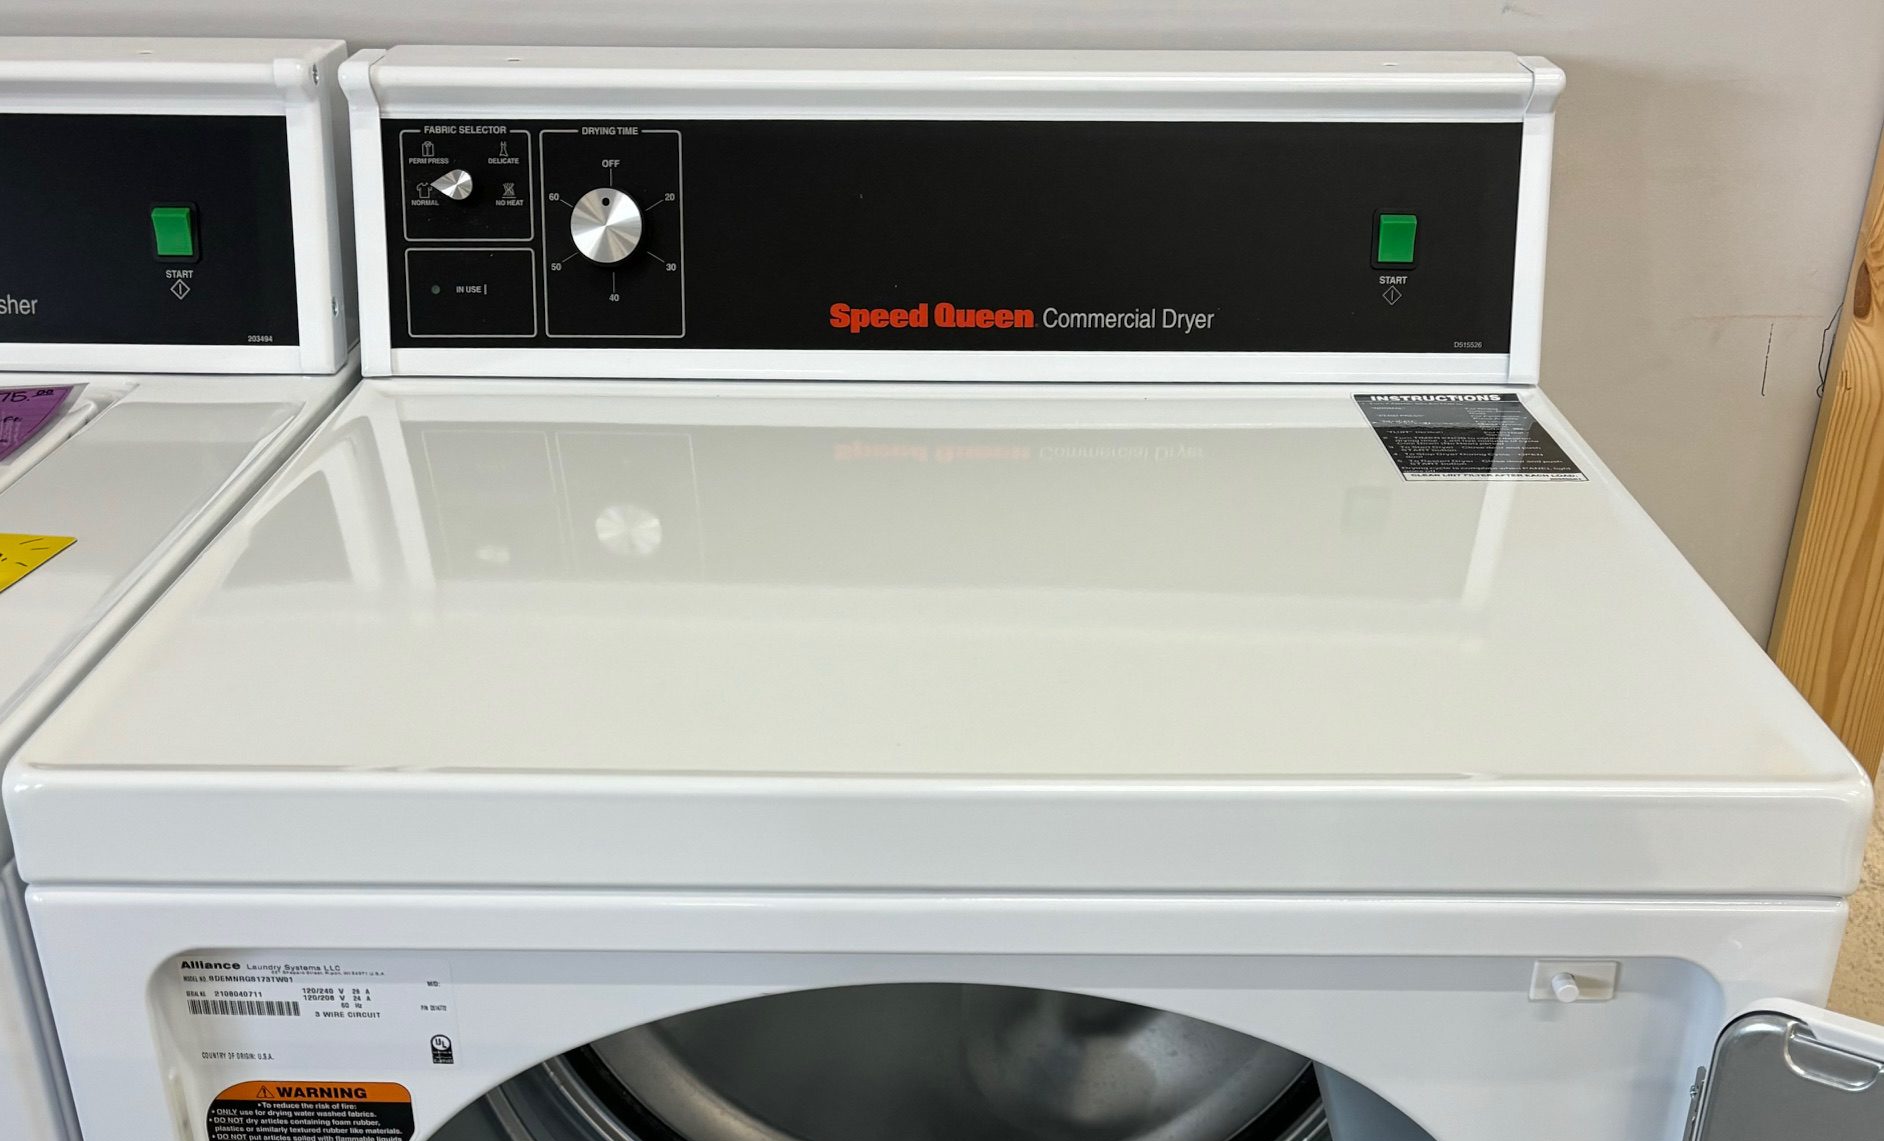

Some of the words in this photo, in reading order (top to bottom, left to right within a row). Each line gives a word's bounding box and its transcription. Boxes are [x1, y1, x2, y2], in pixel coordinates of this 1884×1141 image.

[424, 126, 457, 134] FABRIC
[459, 126, 507, 134] SELECTOR
[582, 127, 616, 135] DRYING
[618, 127, 639, 135] TIME
[602, 160, 620, 168] OFF
[549, 193, 560, 201] 60
[665, 193, 675, 201] 20
[551, 263, 562, 271] 50
[666, 263, 677, 271] 30
[166, 270, 194, 278] START
[1379, 276, 1408, 285] START
[609, 294, 619, 302] 40
[0, 294, 38, 315] sher
[830, 303, 928, 333] Speed
[934, 302, 1034, 329] Queen
[1043, 307, 1156, 329] Commercial
[1162, 308, 1214, 334] Dryer
[181, 961, 240, 970] Alliance
[276, 1087, 367, 1098] WARNING
[290, 1118, 330, 1126] containing
